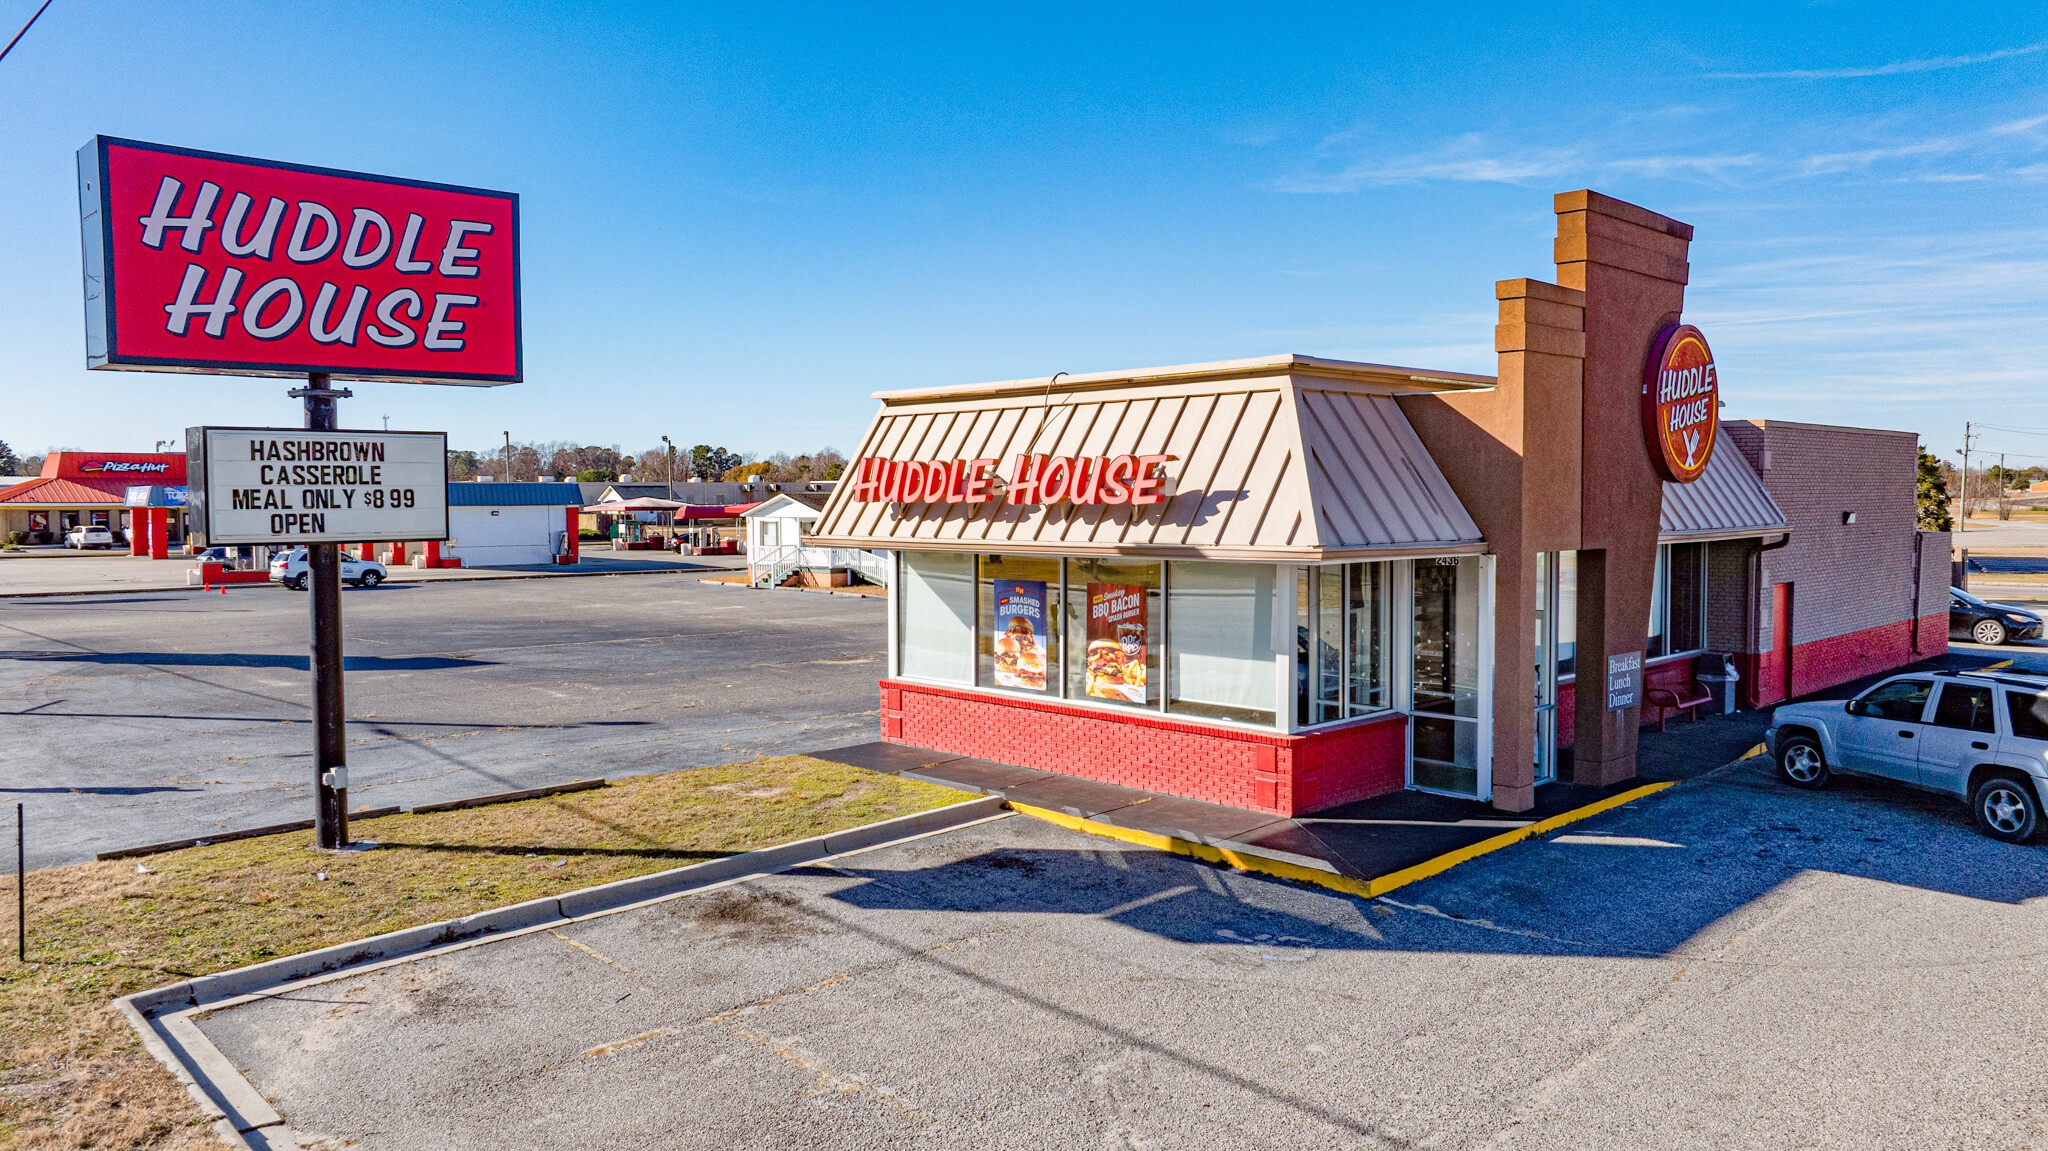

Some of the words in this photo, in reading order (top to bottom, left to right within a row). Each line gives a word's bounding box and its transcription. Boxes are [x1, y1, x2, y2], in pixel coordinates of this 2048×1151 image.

[138, 174, 494, 277] HUDDLE
[163, 262, 480, 352] HOUSE
[1659, 362, 1715, 404] HUDDLE
[1669, 398, 1709, 432] HOUSE
[250, 440, 385, 462] HASHBROWN
[260, 464, 382, 486] CASSEROLE
[853, 456, 1000, 504] HUDDLE
[1006, 453, 1181, 506] HOUSE
[232, 488, 293, 510] MEAL
[302, 488, 356, 509] ONLY
[270, 513, 325, 534] OPEN
[1436, 556, 1460, 566] 2436
[1000, 604, 1041, 619] BURGERS
[1009, 596, 1040, 608] SMASHED
[1092, 601, 1109, 619] BBQ
[1111, 592, 1140, 614] BACON
[1609, 656, 1641, 674] Breakfast
[1609, 673, 1631, 691] Lunch
[1608, 691, 1634, 708] Dinner
